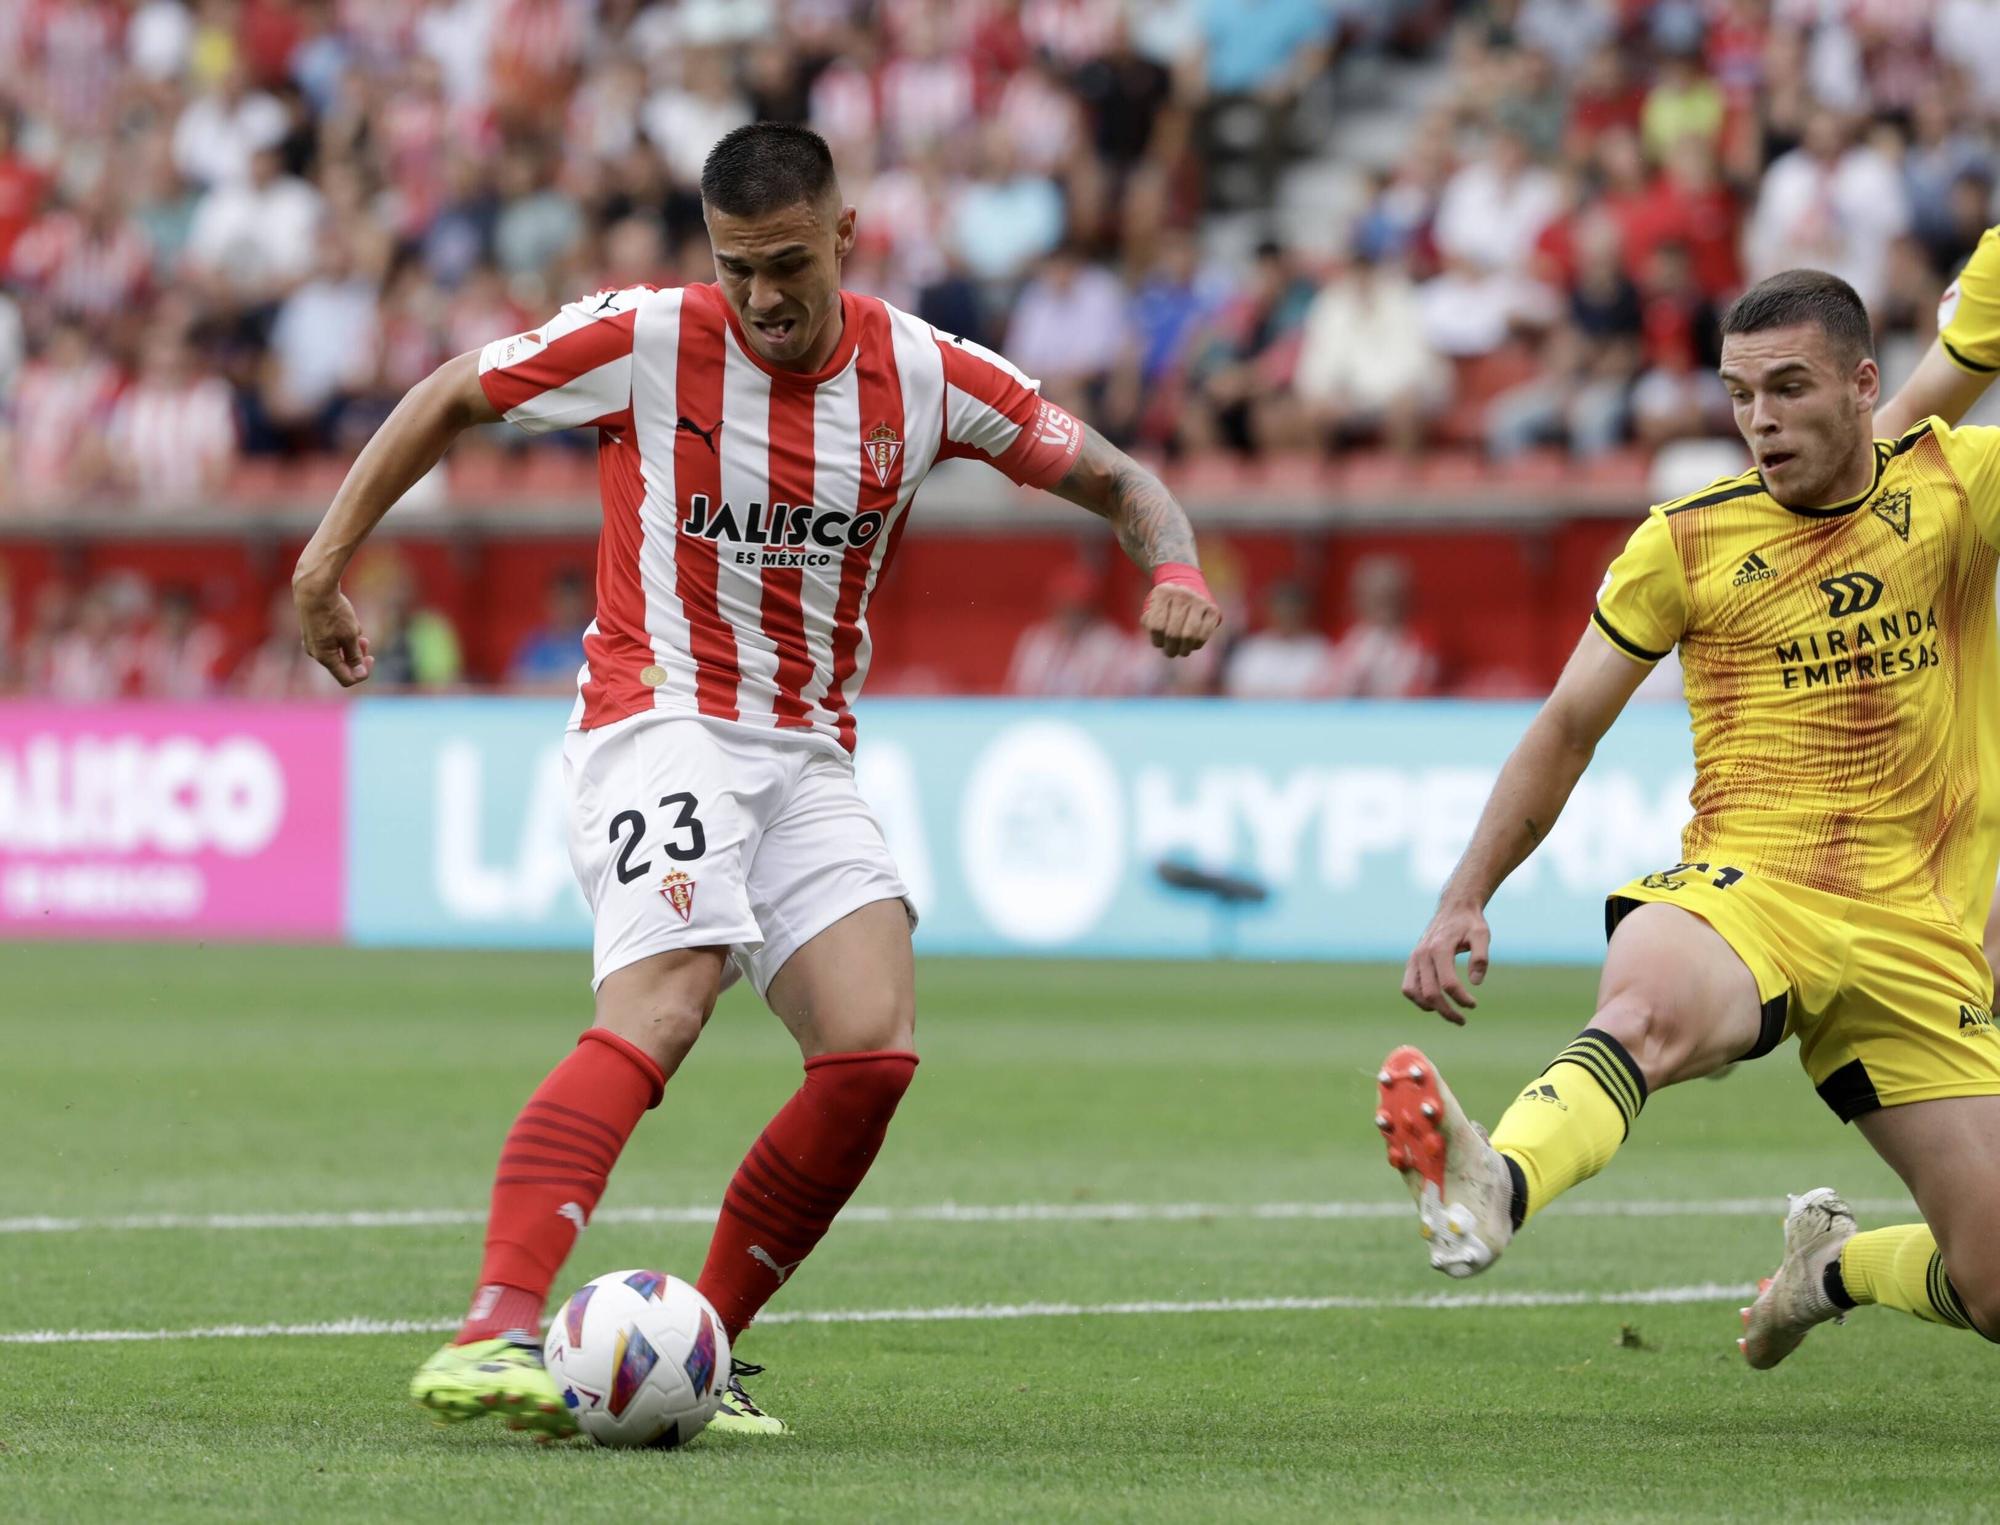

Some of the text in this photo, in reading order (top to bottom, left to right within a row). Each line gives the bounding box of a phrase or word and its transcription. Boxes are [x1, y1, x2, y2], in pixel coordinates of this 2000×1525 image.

[1039, 408, 1073, 445] VS
[683, 495, 882, 548] JALISCO
[735, 550, 831, 567] ES MÉXICO
[1732, 566, 1778, 588] adidas
[1775, 606, 1938, 664] MIRANDA
[1783, 641, 1940, 690] EMPRESAS
[608, 790, 707, 886] 23
